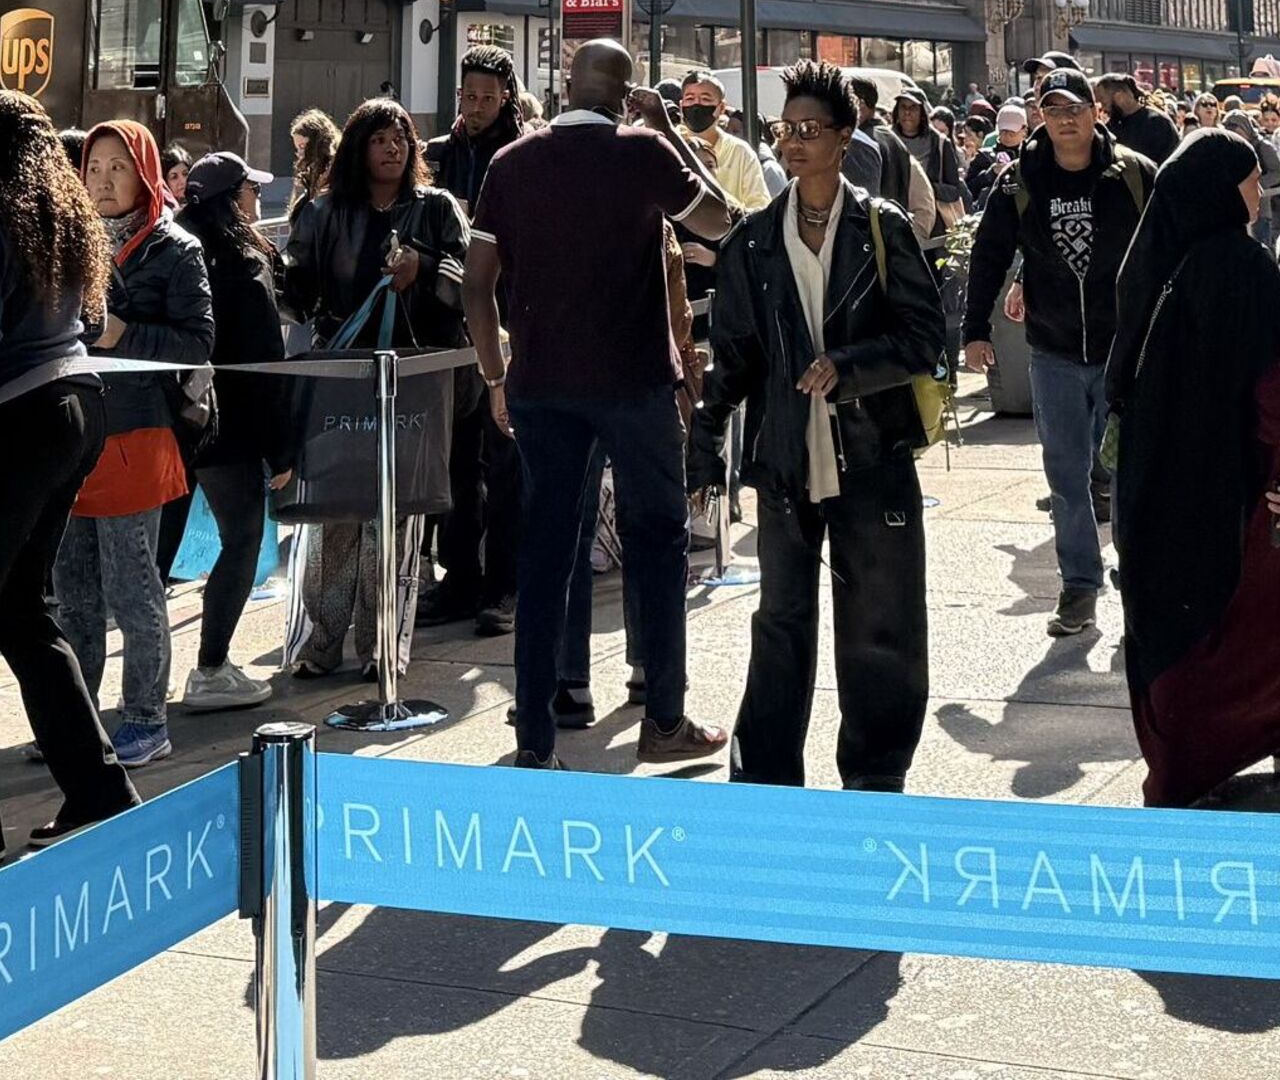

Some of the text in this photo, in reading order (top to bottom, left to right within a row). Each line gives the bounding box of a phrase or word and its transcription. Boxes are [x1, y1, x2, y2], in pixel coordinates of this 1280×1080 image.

[2, 37, 50, 90] ups
[1050, 197, 1094, 217] Breaki
[323, 413, 422, 431] PRIMRK
